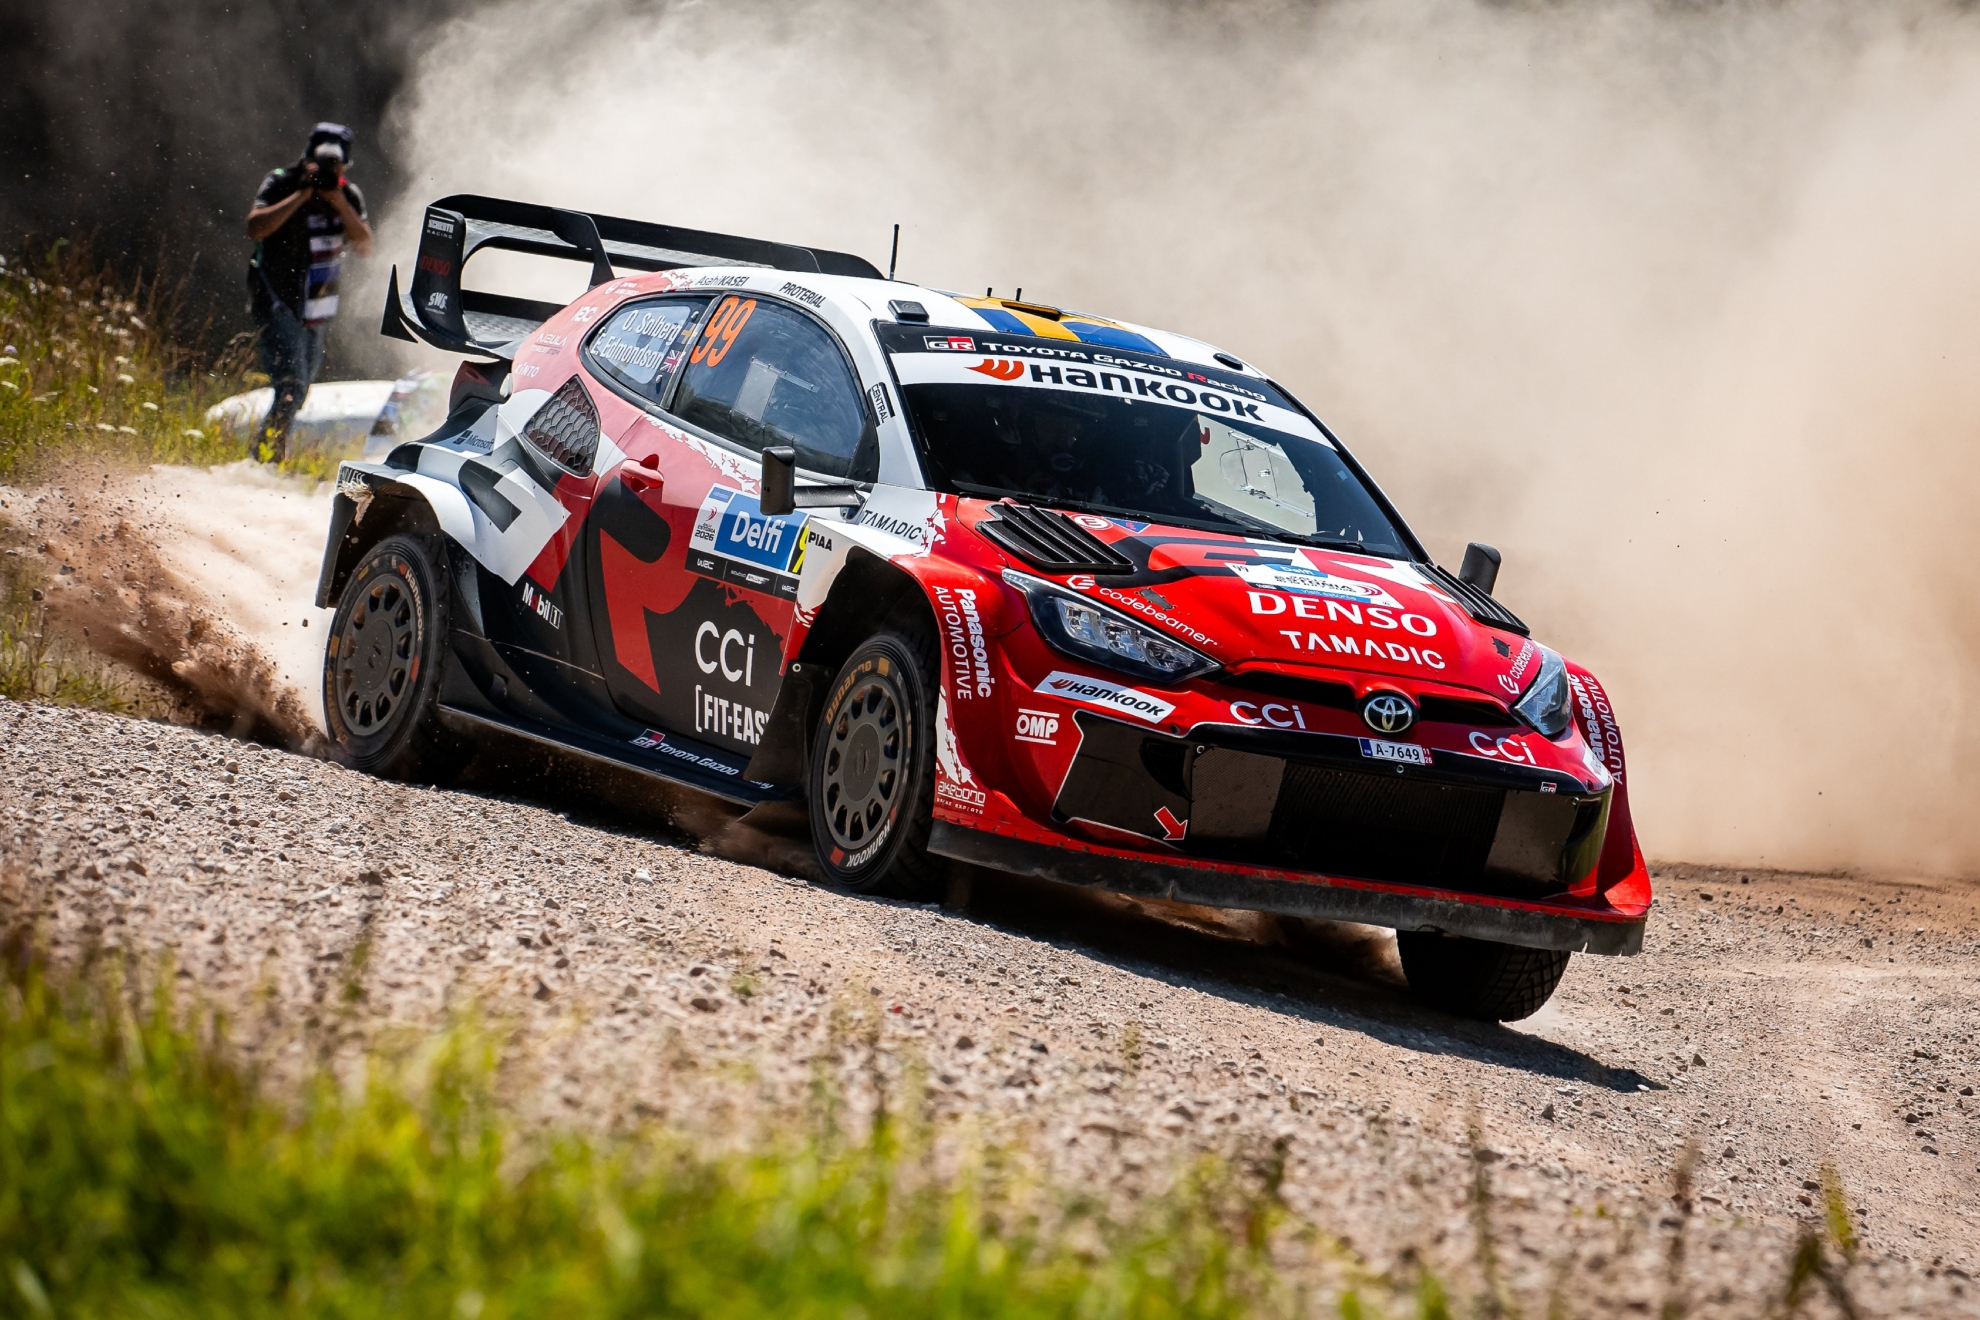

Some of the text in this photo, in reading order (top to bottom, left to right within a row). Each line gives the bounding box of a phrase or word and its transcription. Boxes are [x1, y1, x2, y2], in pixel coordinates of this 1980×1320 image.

[428, 292, 448, 309] SWS
[779, 282, 826, 308] PROTERIAL
[636, 312, 682, 346] Solberg
[690, 296, 757, 367] 99
[600, 336, 665, 370] Edmondson
[982, 342, 1086, 360] TOYOTA
[1187, 371, 1266, 401] Racing
[871, 384, 889, 424] CENTRAL
[694, 529, 715, 542] 2026
[730, 510, 787, 554] Delfi
[808, 531, 833, 552] PIAA
[860, 509, 922, 540] TAMADIC
[522, 582, 551, 621] Mobil
[1099, 587, 1217, 647] codebeamer
[1246, 591, 1438, 637] DENSO
[694, 620, 755, 687] CCi
[932, 585, 973, 700] AUTOMOTIVE
[1279, 630, 1446, 670] TAMADIC
[1016, 714, 1059, 739] OMP
[1229, 700, 1306, 730] CCi
[1580, 674, 1623, 785] AUTOMOTIVE
[1375, 743, 1420, 761] A-7649
[1468, 730, 1537, 766] CCi
